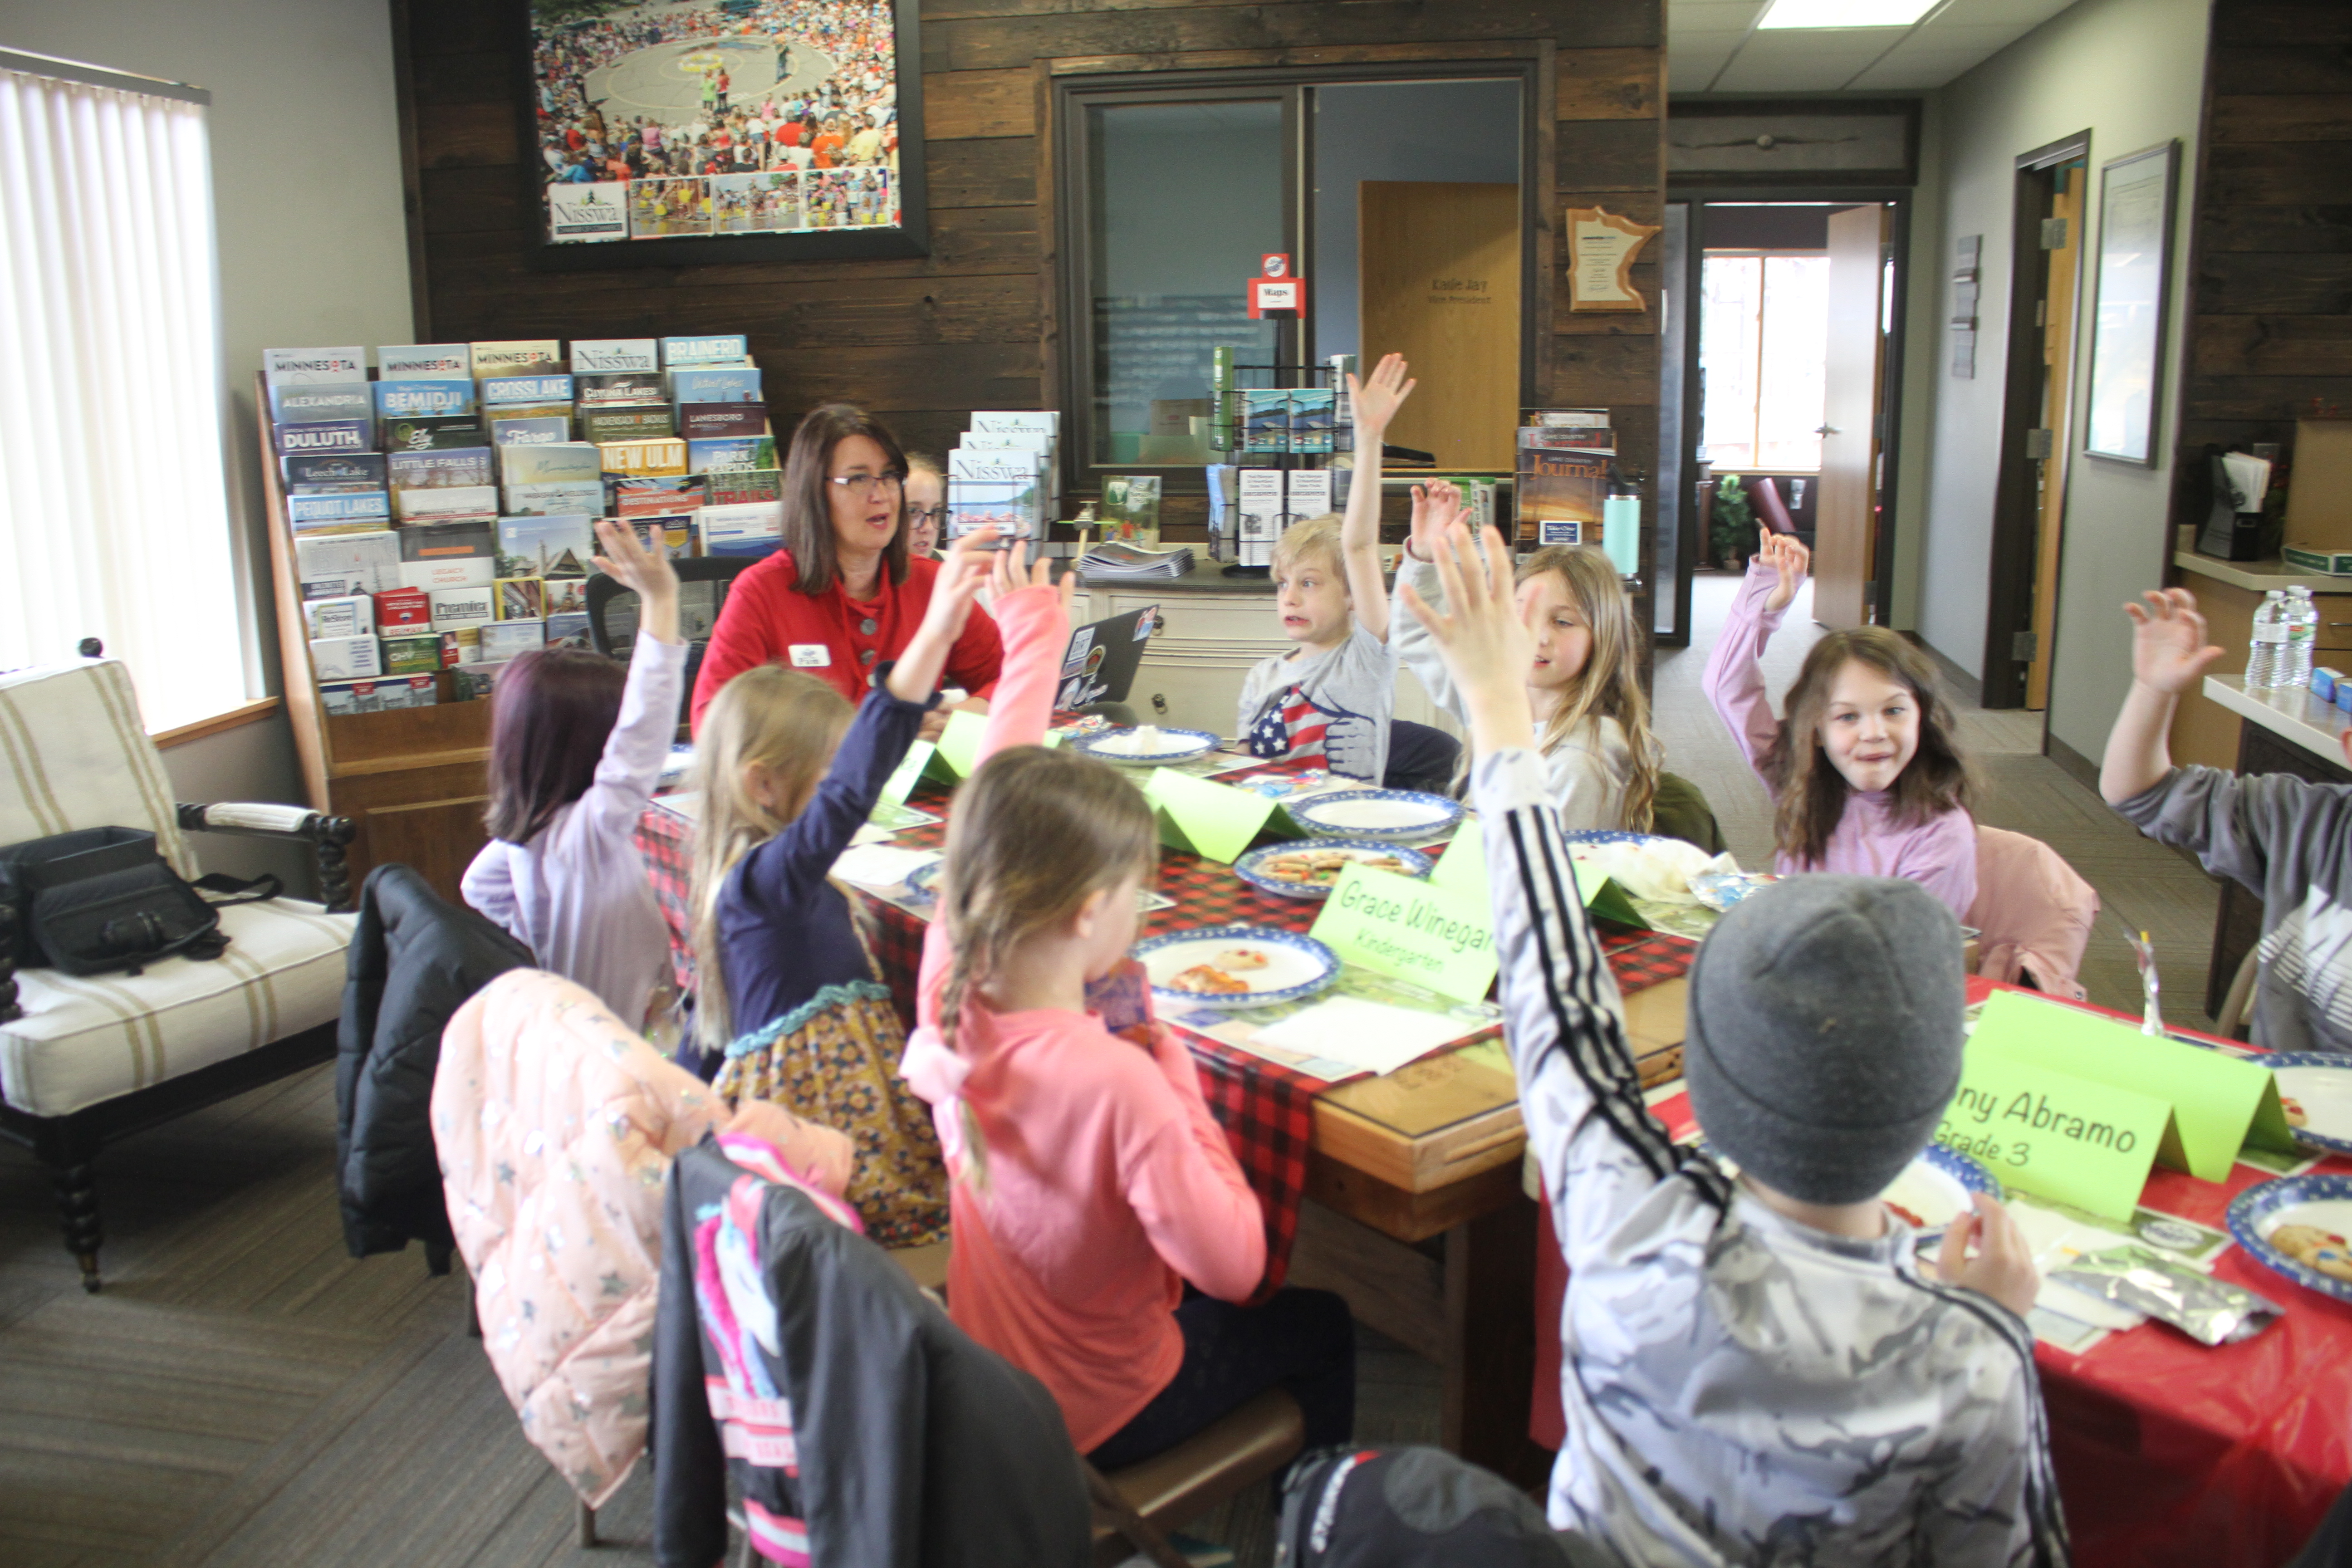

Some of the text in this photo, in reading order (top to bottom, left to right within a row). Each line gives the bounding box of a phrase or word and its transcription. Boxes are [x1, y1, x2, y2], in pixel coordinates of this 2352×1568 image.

[666, 338, 742, 357] BRAINERD
[387, 360, 460, 371] MINNESOTA
[478, 352, 553, 363] MINNESOTA
[275, 360, 356, 372] MINNESOTA
[283, 395, 365, 408] ALEXANDRIA
[385, 392, 462, 408] BEMIDJI
[689, 413, 744, 422] LANESBORO
[284, 431, 359, 448] DULUTH
[392, 460, 435, 470] LITTLE
[436, 457, 476, 467] FALLS
[603, 446, 643, 470] NEW
[646, 445, 683, 468] ULM
[712, 451, 751, 462] PARK
[1529, 455, 1607, 480] Journal
[712, 490, 774, 505] TRAILS
[295, 498, 383, 516] PEQUOT LAKES
[435, 600, 488, 614] Premier
[1342, 880, 1401, 921] Grace
[1355, 928, 1444, 973] Kindergarten
[2003, 1092, 2137, 1154] Abramo
[1934, 1120, 2032, 1167] Grade 3
